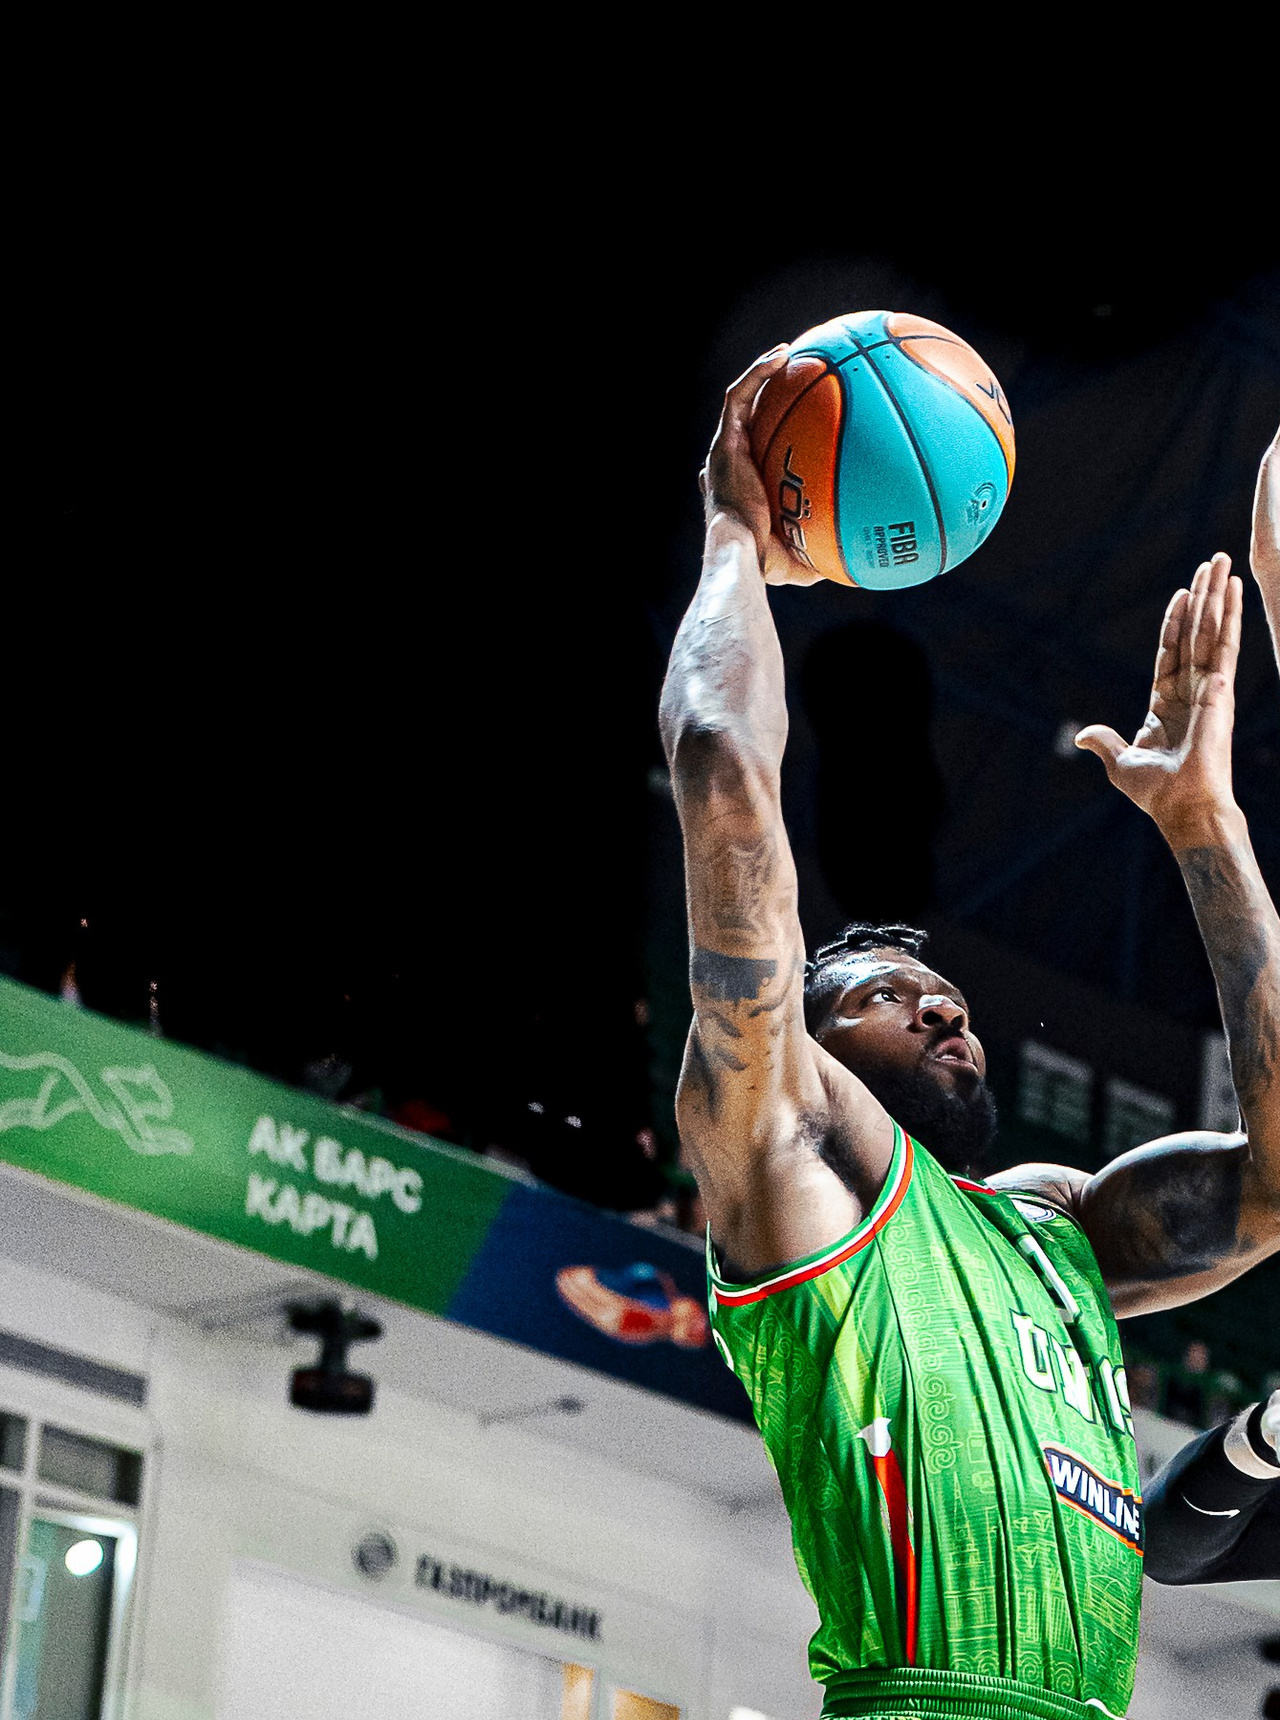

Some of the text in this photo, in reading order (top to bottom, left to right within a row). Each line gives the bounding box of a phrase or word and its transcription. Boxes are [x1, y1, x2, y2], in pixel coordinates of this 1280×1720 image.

[873, 526, 890, 568] APPROVED
[888, 521, 919, 566] FIBA
[246, 1173, 378, 1261] КАРТА
